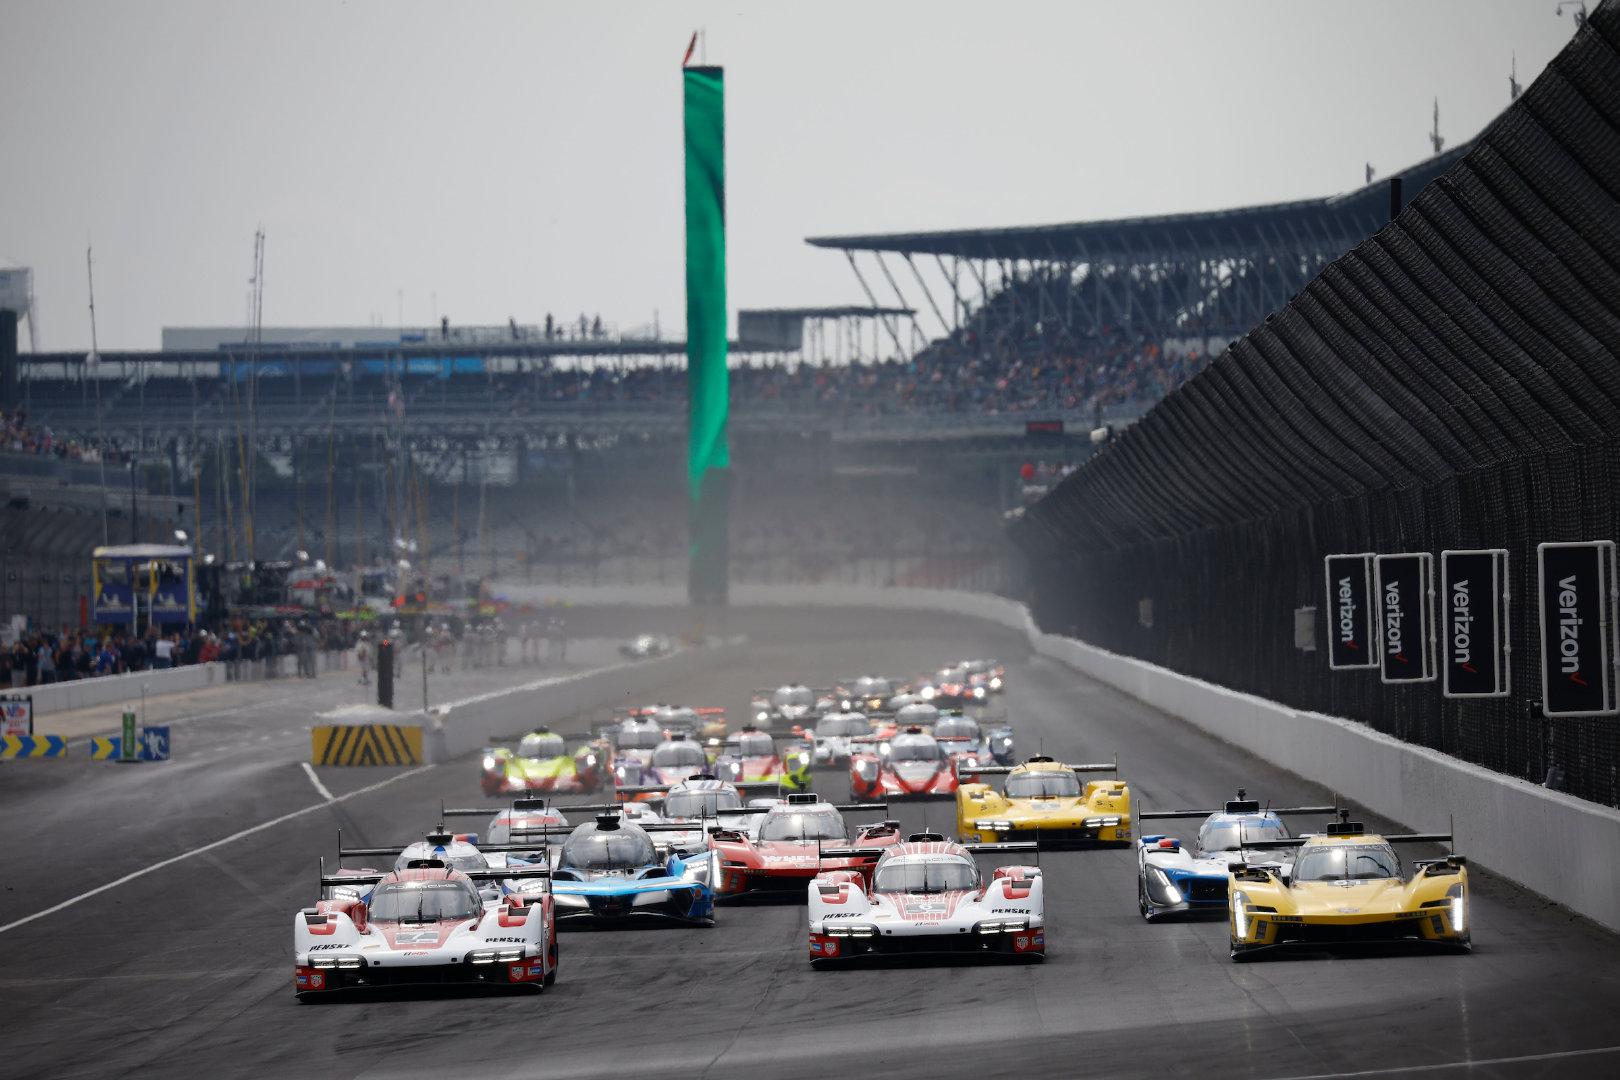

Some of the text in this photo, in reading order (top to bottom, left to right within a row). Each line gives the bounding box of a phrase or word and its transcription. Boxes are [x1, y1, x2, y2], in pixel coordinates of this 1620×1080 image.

[1339, 576, 1356, 642] verizon
[1385, 581, 1404, 654] verizon
[1453, 580, 1474, 663] verizon
[1558, 575, 1583, 673] verizon
[309, 943, 352, 952] PENSKE
[822, 912, 864, 921] PENSKE
